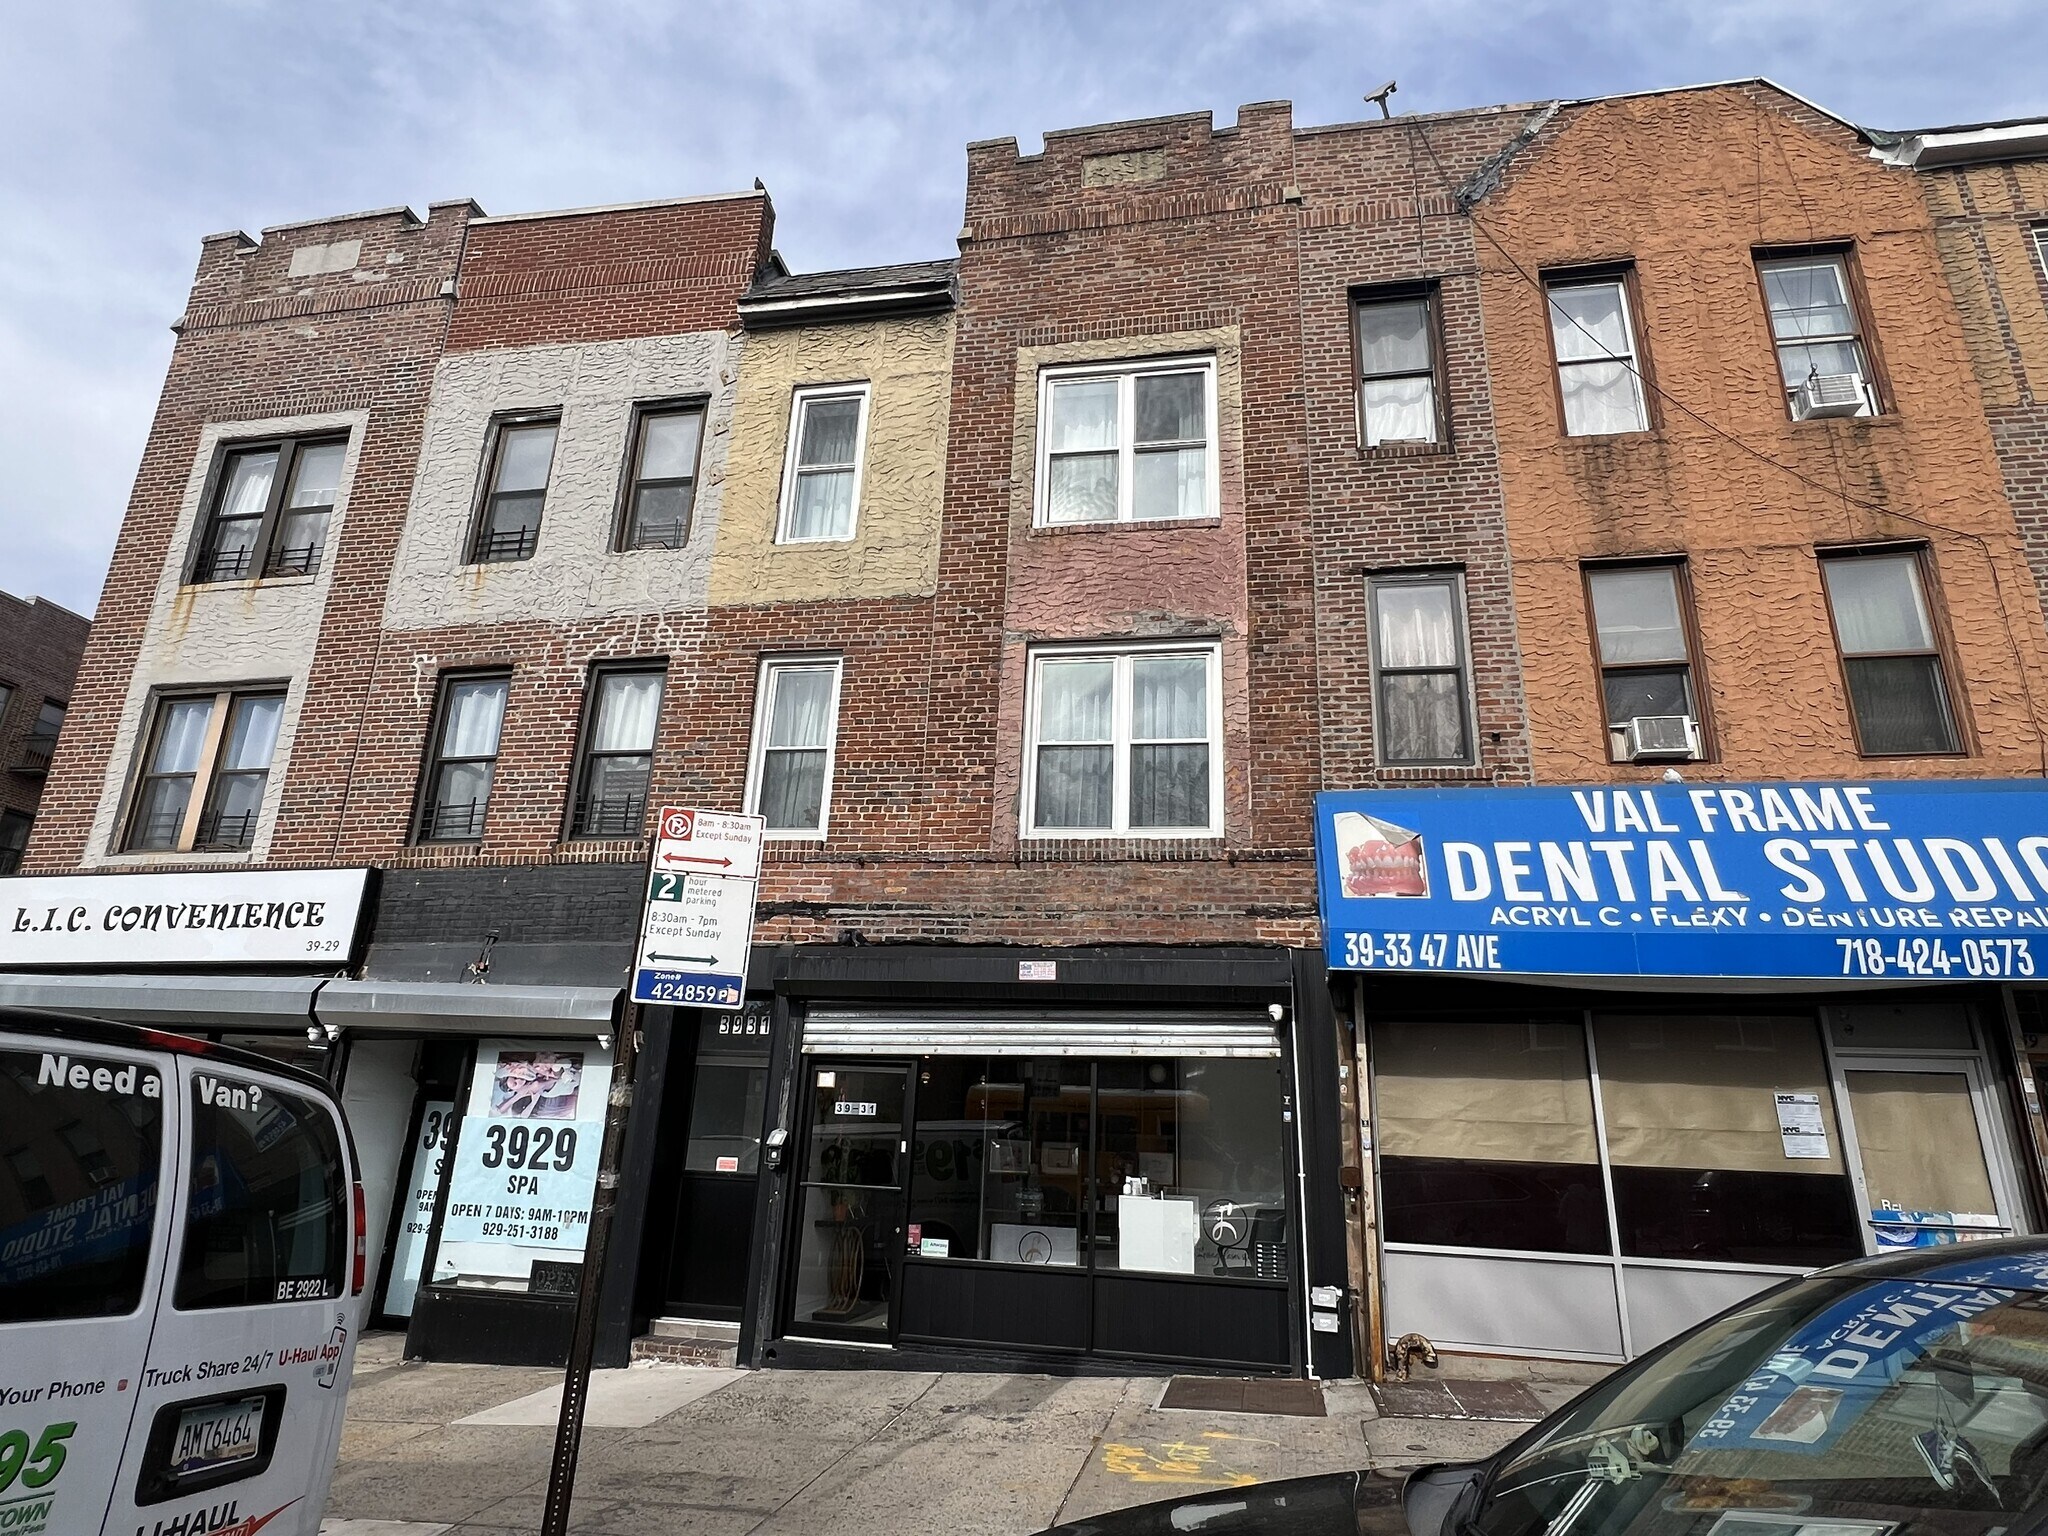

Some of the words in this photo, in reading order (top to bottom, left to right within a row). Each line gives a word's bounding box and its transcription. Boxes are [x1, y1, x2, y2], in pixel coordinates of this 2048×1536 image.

[1571, 789, 1680, 833] VAL
[1688, 787, 1891, 833] FRAME
[697, 818, 715, 828] 8am
[721, 820, 752, 831] 8:30am
[695, 829, 722, 841] Except
[724, 832, 753, 844] Sunday
[688, 877, 708, 886] hour
[1442, 840, 1751, 902] DENTAL
[657, 873, 678, 900] 2
[687, 887, 723, 897] metered
[685, 896, 717, 907] parking
[11, 906, 92, 933] L.I.C.
[103, 901, 326, 932] CONVENIENCE
[651, 911, 688, 924] 8:30am
[698, 915, 718, 927] 7pm
[1949, 906, 2048, 928] REPAI
[649, 924, 683, 937] Except
[685, 926, 721, 941] Sunday
[305, 939, 340, 952] 39-29
[1344, 932, 1413, 967] 39-33
[1419, 934, 1448, 967] 47
[1456, 934, 1501, 969] AVE
[1835, 938, 2036, 977] 718-424-0573
[650, 982, 717, 1002] 424859
[720, 1016, 769, 1034] 3931
[37, 1054, 137, 1095] Need
[142, 1074, 161, 1098] a
[199, 1076, 263, 1112] Van?
[836, 1103, 875, 1114] 39-31
[482, 1124, 578, 1172] 3929
[507, 1174, 539, 1196] SPA
[451, 1203, 482, 1218] OPEN
[485, 1204, 492, 1218] 7
[495, 1206, 525, 1221] DAYS:
[482, 1222, 559, 1241] 929-251-3188
[276, 1281, 295, 1300] BE
[295, 1279, 321, 1298] 2922
[322, 1278, 329, 1296] L
[0, 1387, 44, 1406] Your
[47, 1380, 106, 1400] Phone
[146, 1363, 193, 1388] Truck
[196, 1360, 240, 1380] Share
[242, 1350, 274, 1374] 24/7
[278, 1345, 318, 1367] U-Haul
[319, 1343, 340, 1362] App
[178, 1413, 252, 1459] AM76464
[0, 1500, 53, 1528] OWN
